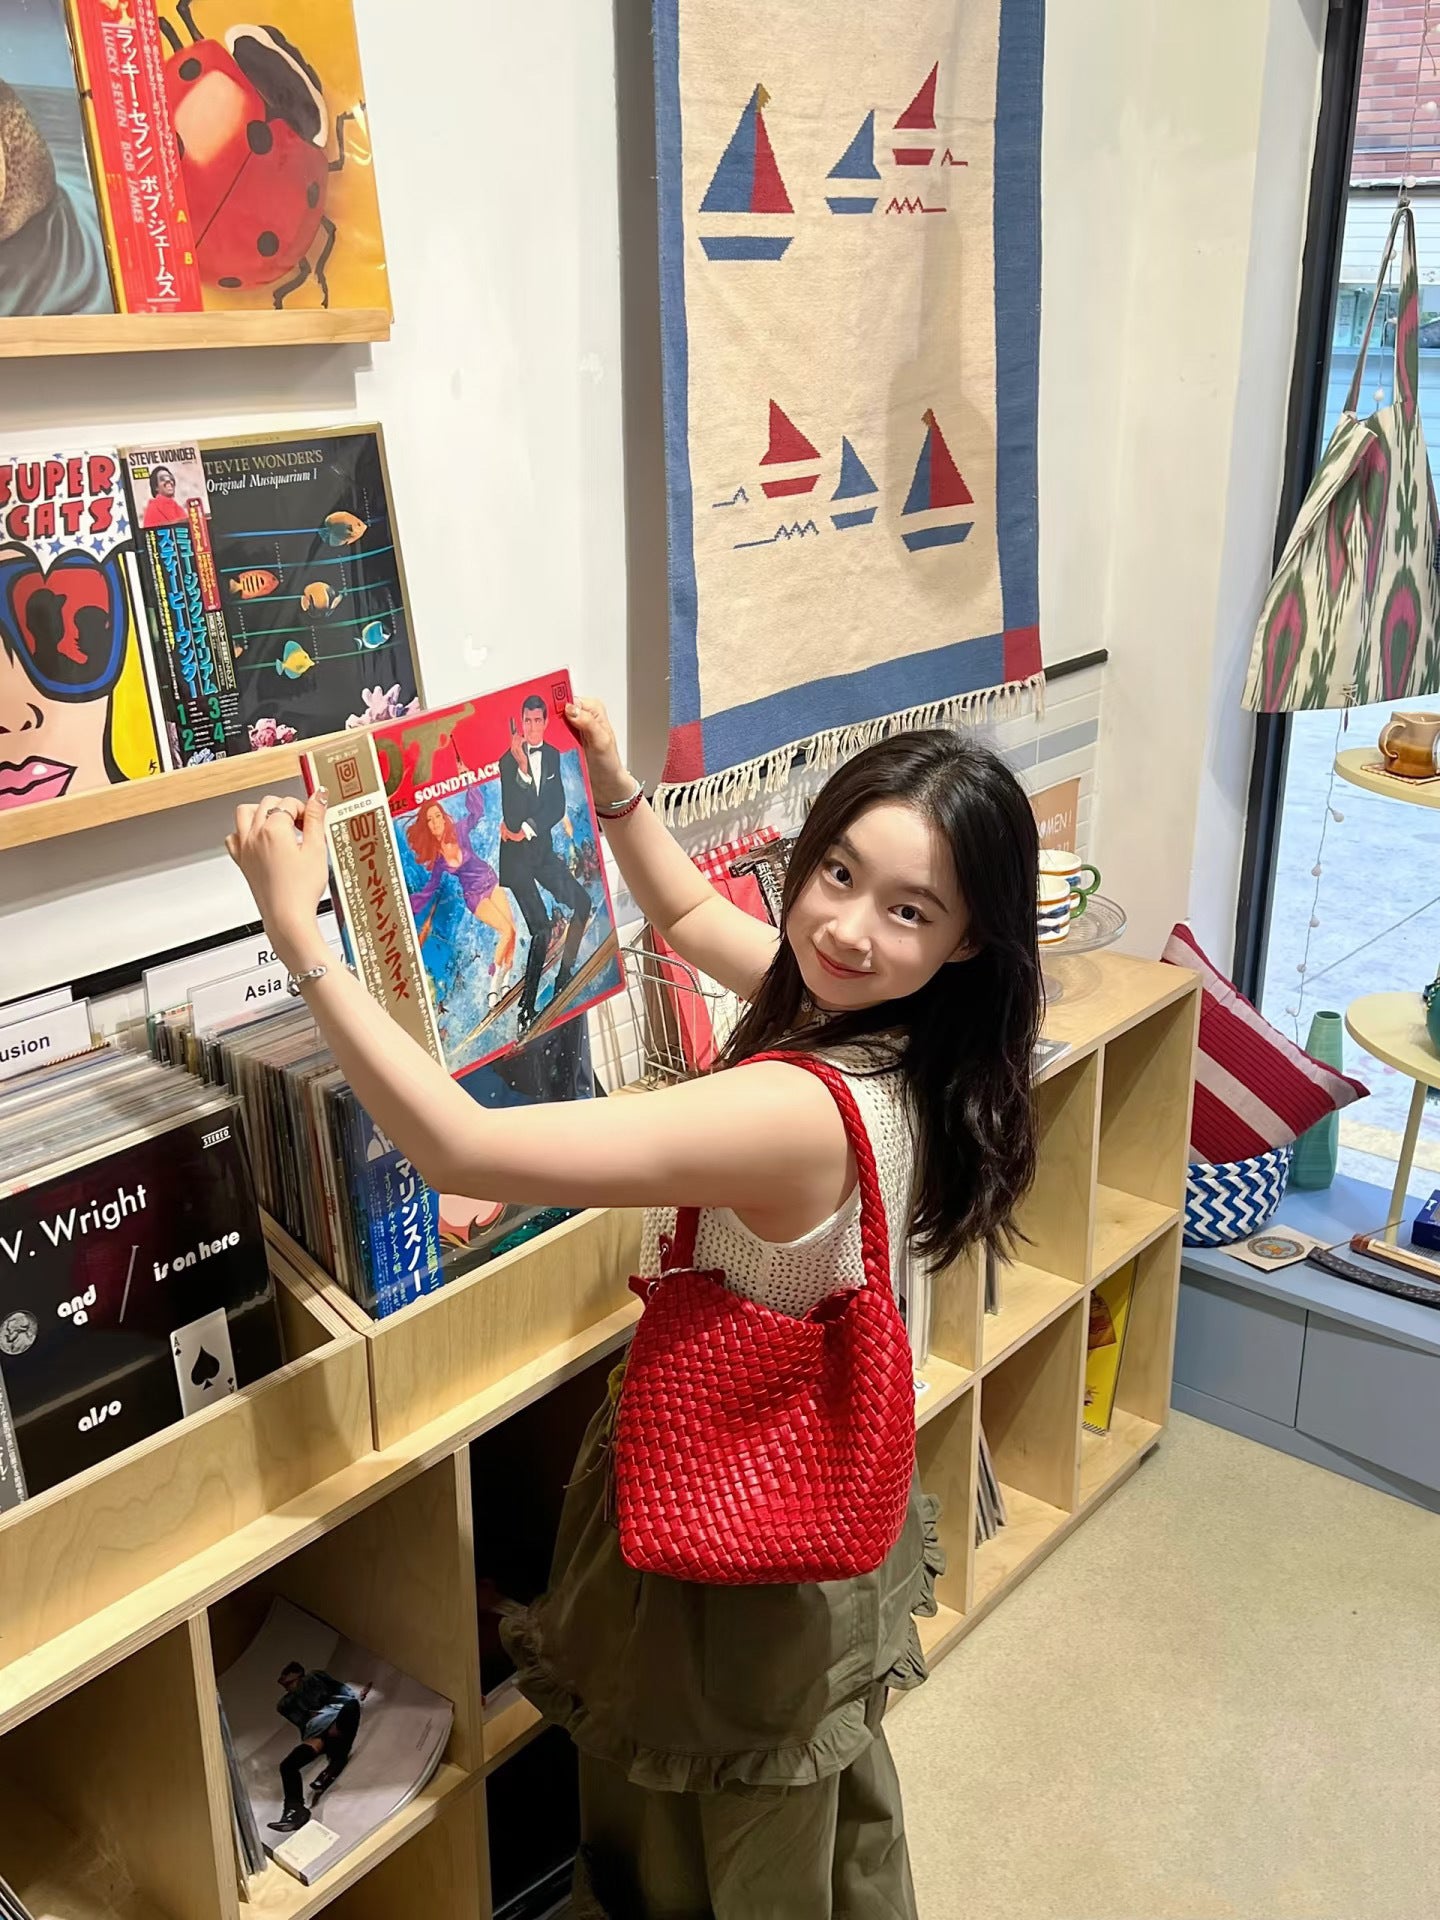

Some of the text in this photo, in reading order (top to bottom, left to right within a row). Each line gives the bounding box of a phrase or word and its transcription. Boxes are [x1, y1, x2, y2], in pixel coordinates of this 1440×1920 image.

[102, 28, 145, 224] LUCKY SEVEN BOB JAMES
[128, 446, 198, 467] STEVIE WONDER
[203, 448, 324, 476] TEVIE WONDER'S
[206, 473, 246, 495] Original
[249, 469, 311, 489] Musiquarium
[5, 496, 115, 542] CATS
[208, 697, 221, 719] 3
[182, 729, 196, 752] 2
[213, 722, 225, 743] 4
[414, 761, 501, 805] SOUNDTRACK
[337, 799, 373, 817] STEREO
[350, 811, 377, 842] 007
[257, 950, 279, 965] Ro
[244, 979, 282, 1001] Asia
[0, 1035, 50, 1063] usion
[203, 1129, 230, 1147] STEREO
[39, 1184, 147, 1247] Wright
[153, 1231, 240, 1282] is on here
[57, 1284, 97, 1318] and
[73, 1310, 89, 1326] a
[173, 1336, 181, 1348] A
[78, 1400, 122, 1432] also
